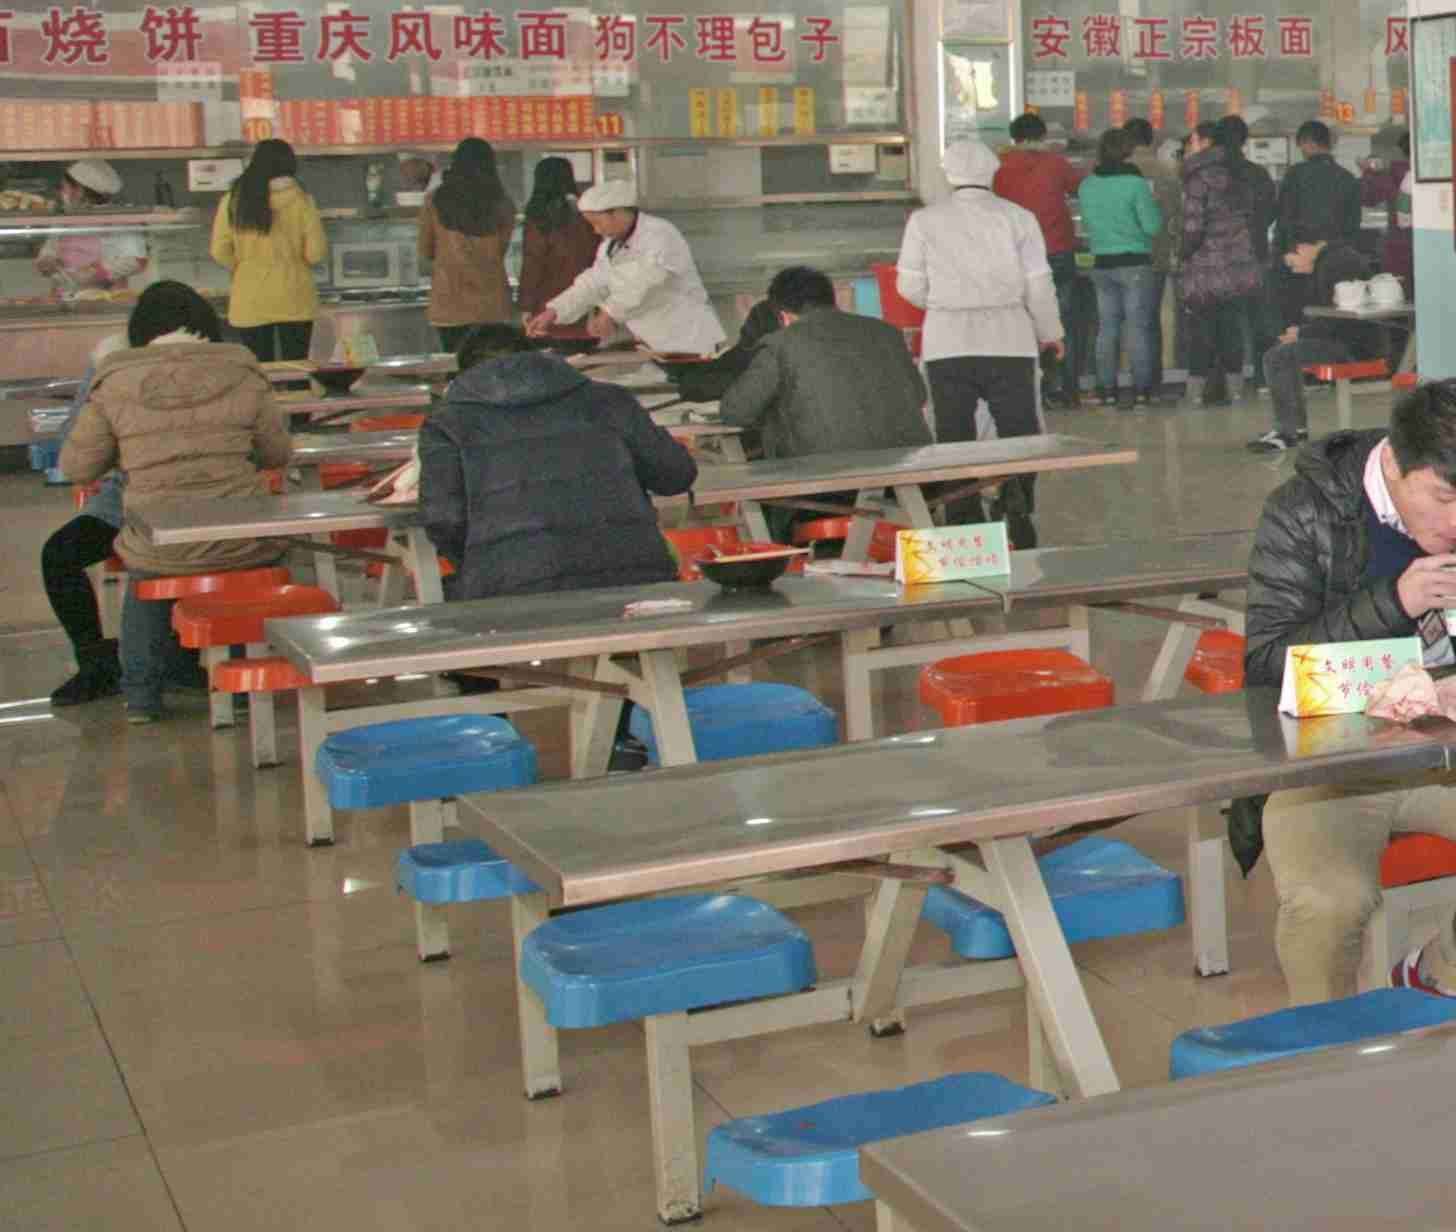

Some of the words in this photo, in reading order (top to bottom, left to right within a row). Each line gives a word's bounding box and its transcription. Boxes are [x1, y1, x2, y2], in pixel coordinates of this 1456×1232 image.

[0, 7, 202, 65] 烧饼
[248, 10, 569, 62] 重庆风味面
[594, 15, 840, 62] 狗不理包子
[1031, 15, 1313, 59] 安徽正宗板面
